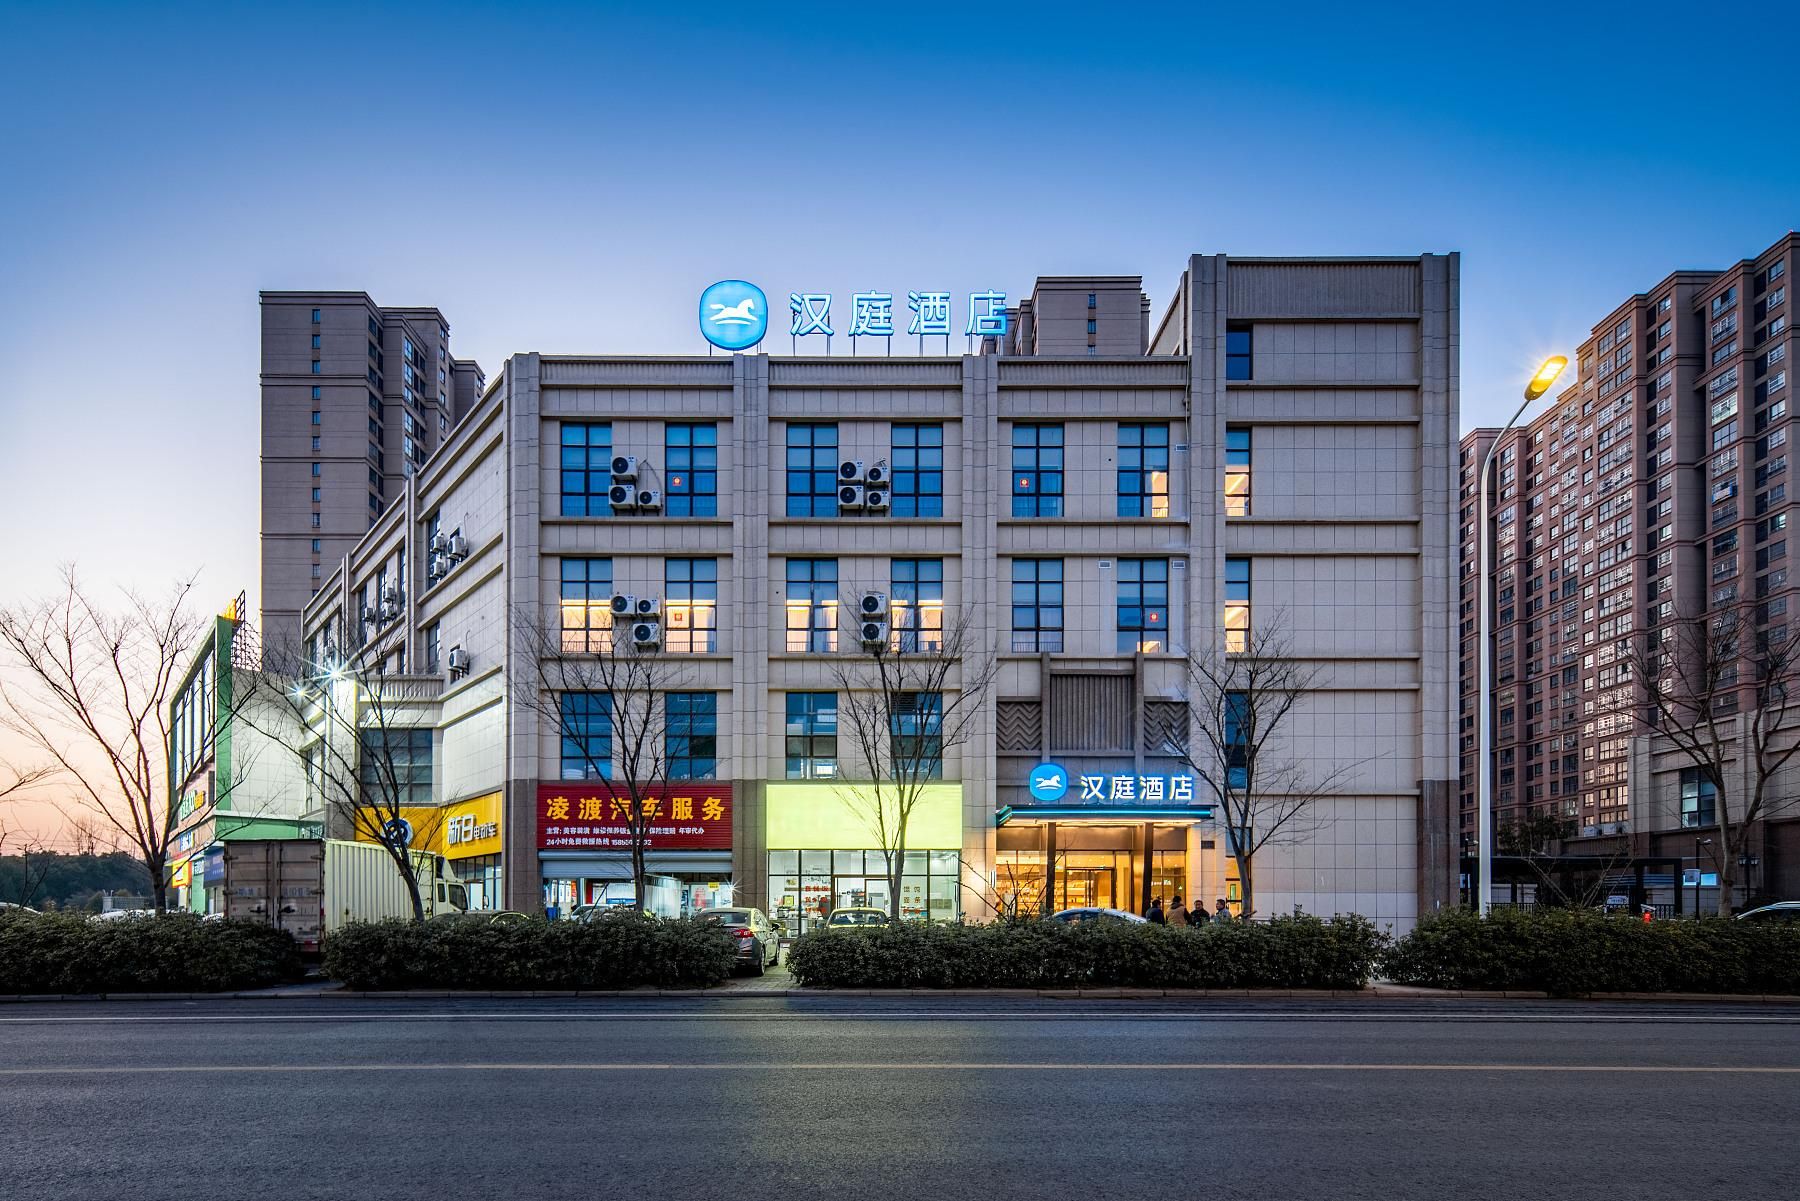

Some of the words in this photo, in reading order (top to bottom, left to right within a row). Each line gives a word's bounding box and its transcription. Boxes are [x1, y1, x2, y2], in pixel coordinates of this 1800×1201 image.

[789, 289, 1008, 337] 汉庭酒店
[1080, 775, 1193, 800] 汉庭酒店
[546, 797, 724, 820] 凌渡汽车服务
